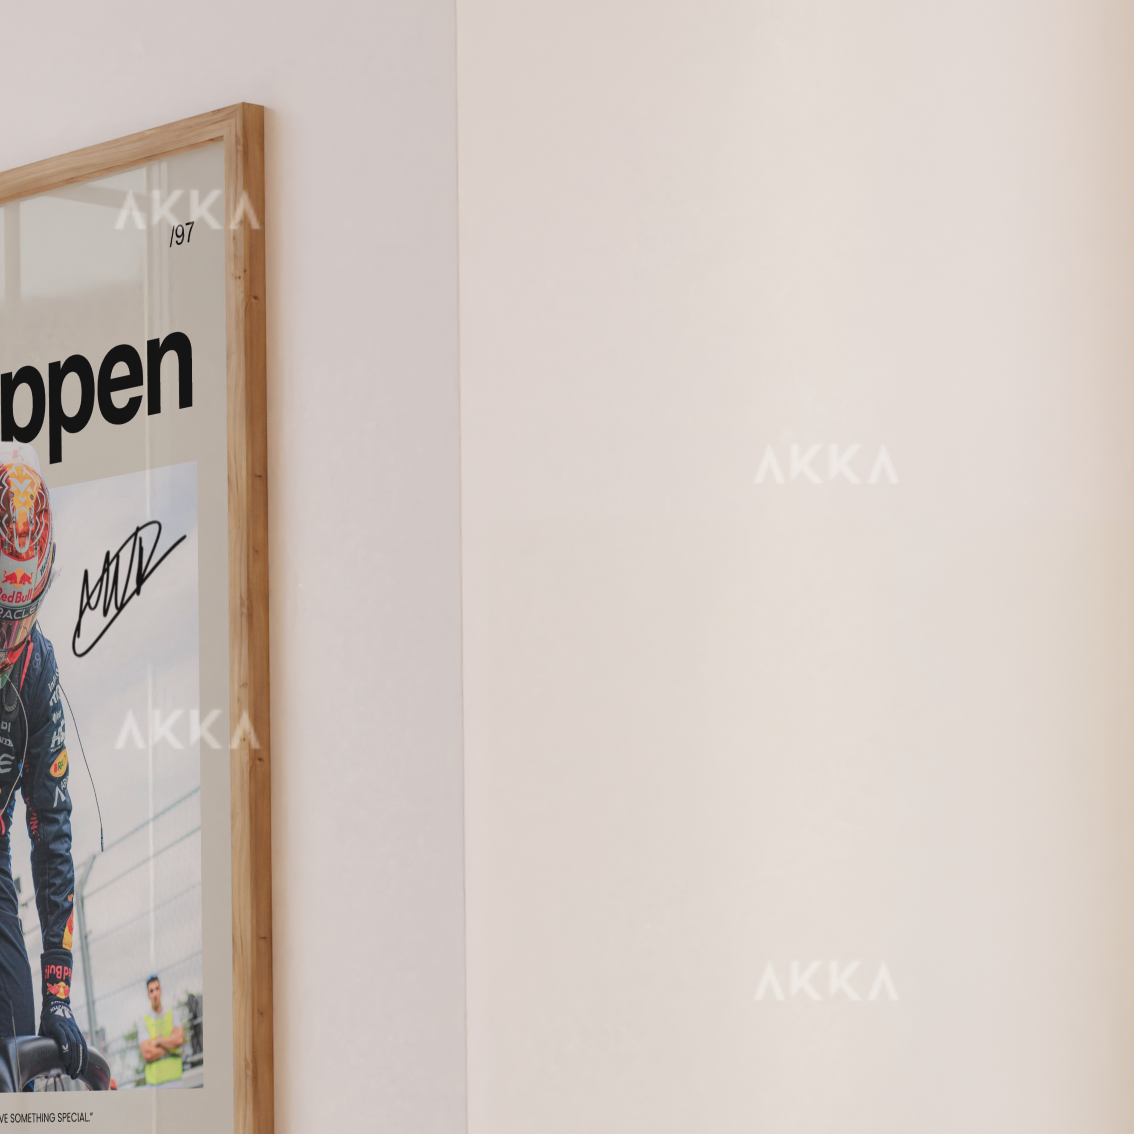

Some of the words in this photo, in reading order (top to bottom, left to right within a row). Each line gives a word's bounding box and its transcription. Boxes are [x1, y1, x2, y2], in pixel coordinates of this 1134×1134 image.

[169, 221, 195, 248] /97
[15, 588, 33, 604] Bull
[10, 1113, 56, 1123] SOMETHING
